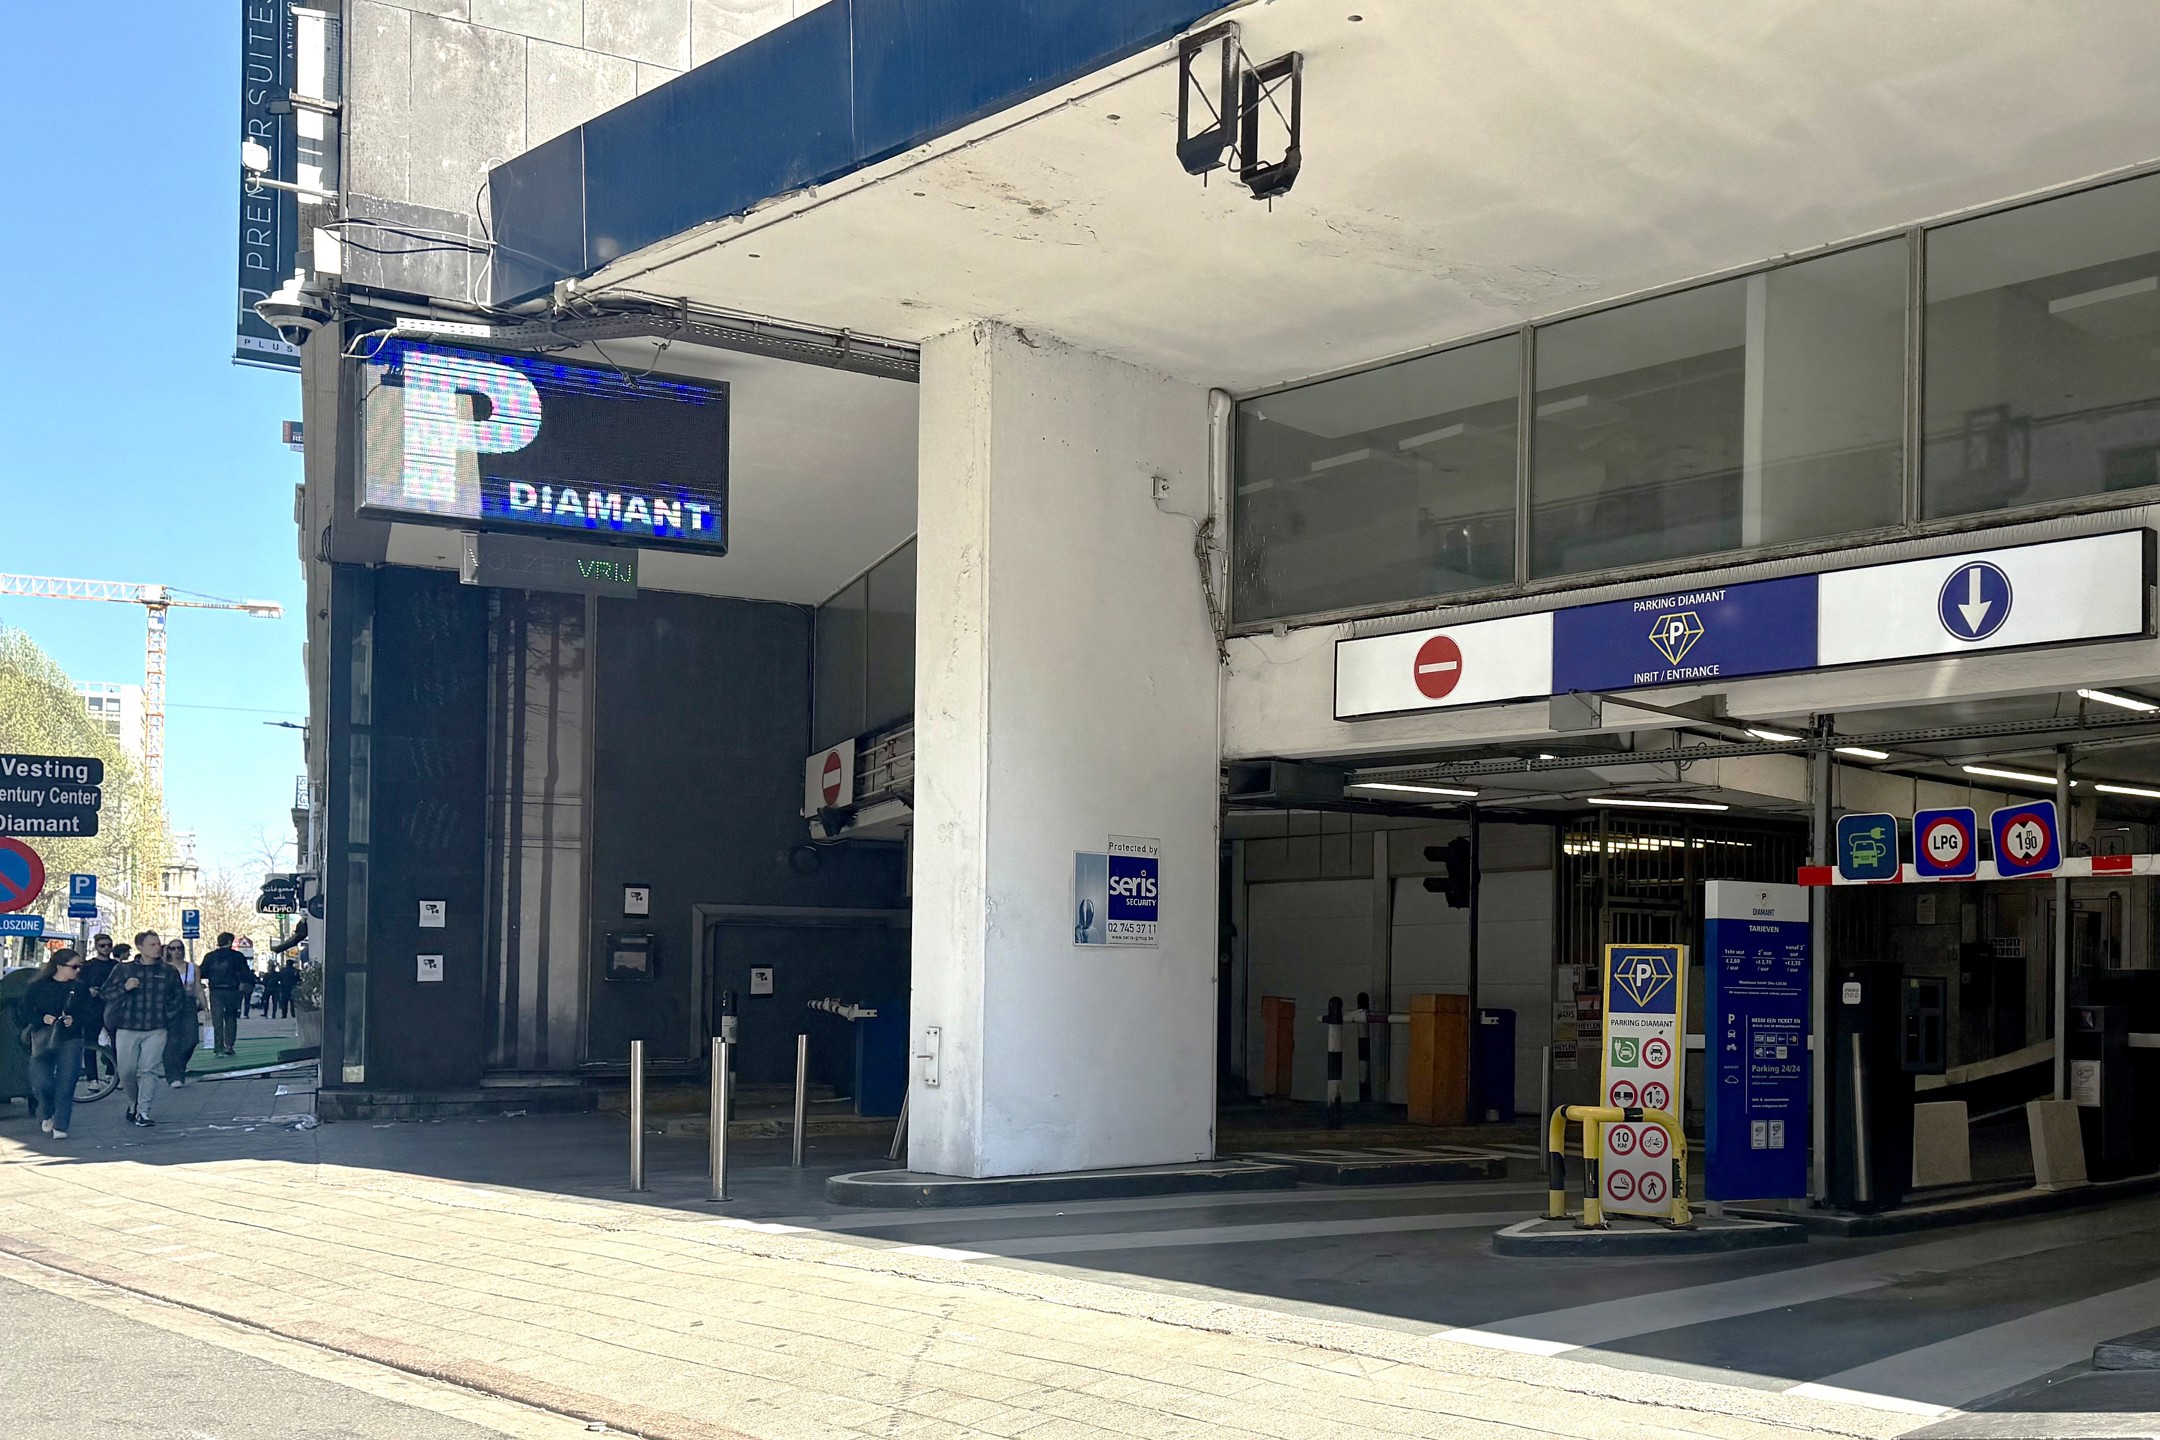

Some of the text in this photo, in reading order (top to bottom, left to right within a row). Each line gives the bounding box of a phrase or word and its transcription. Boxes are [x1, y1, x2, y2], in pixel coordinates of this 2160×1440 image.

[248, 0, 273, 106] SUITE
[244, 338, 294, 353] PLUS
[403, 350, 542, 502] P
[509, 481, 711, 531] DIAMANT
[577, 558, 632, 583] VRIJ
[1633, 590, 1726, 612] PARKING DIAMANT
[1669, 621, 1684, 645] P
[1633, 671, 1659, 684] INRIT
[1666, 664, 1720, 680] ENTRANCE
[1, 757, 89, 783] Vesting
[50, 787, 98, 805] Center
[1108, 841, 1158, 855] Protected by
[1933, 834, 1958, 850] LPG
[75, 876, 90, 894] P
[1109, 869, 1157, 897] seris
[1126, 898, 1157, 907] SECURITY
[185, 911, 196, 923] P
[1752, 908, 1775, 916] DIAMANT
[1108, 922, 1157, 934] 02 745 37 11
[1749, 925, 1779, 933] TARIEVEN
[1636, 963, 1652, 987] P
[1610, 1019, 1674, 1028] PARKING DIAMANT
[1728, 1013, 1735, 1024] P
[1751, 1064, 1779, 1074] Parking
[1615, 1132, 1629, 1142] 10
